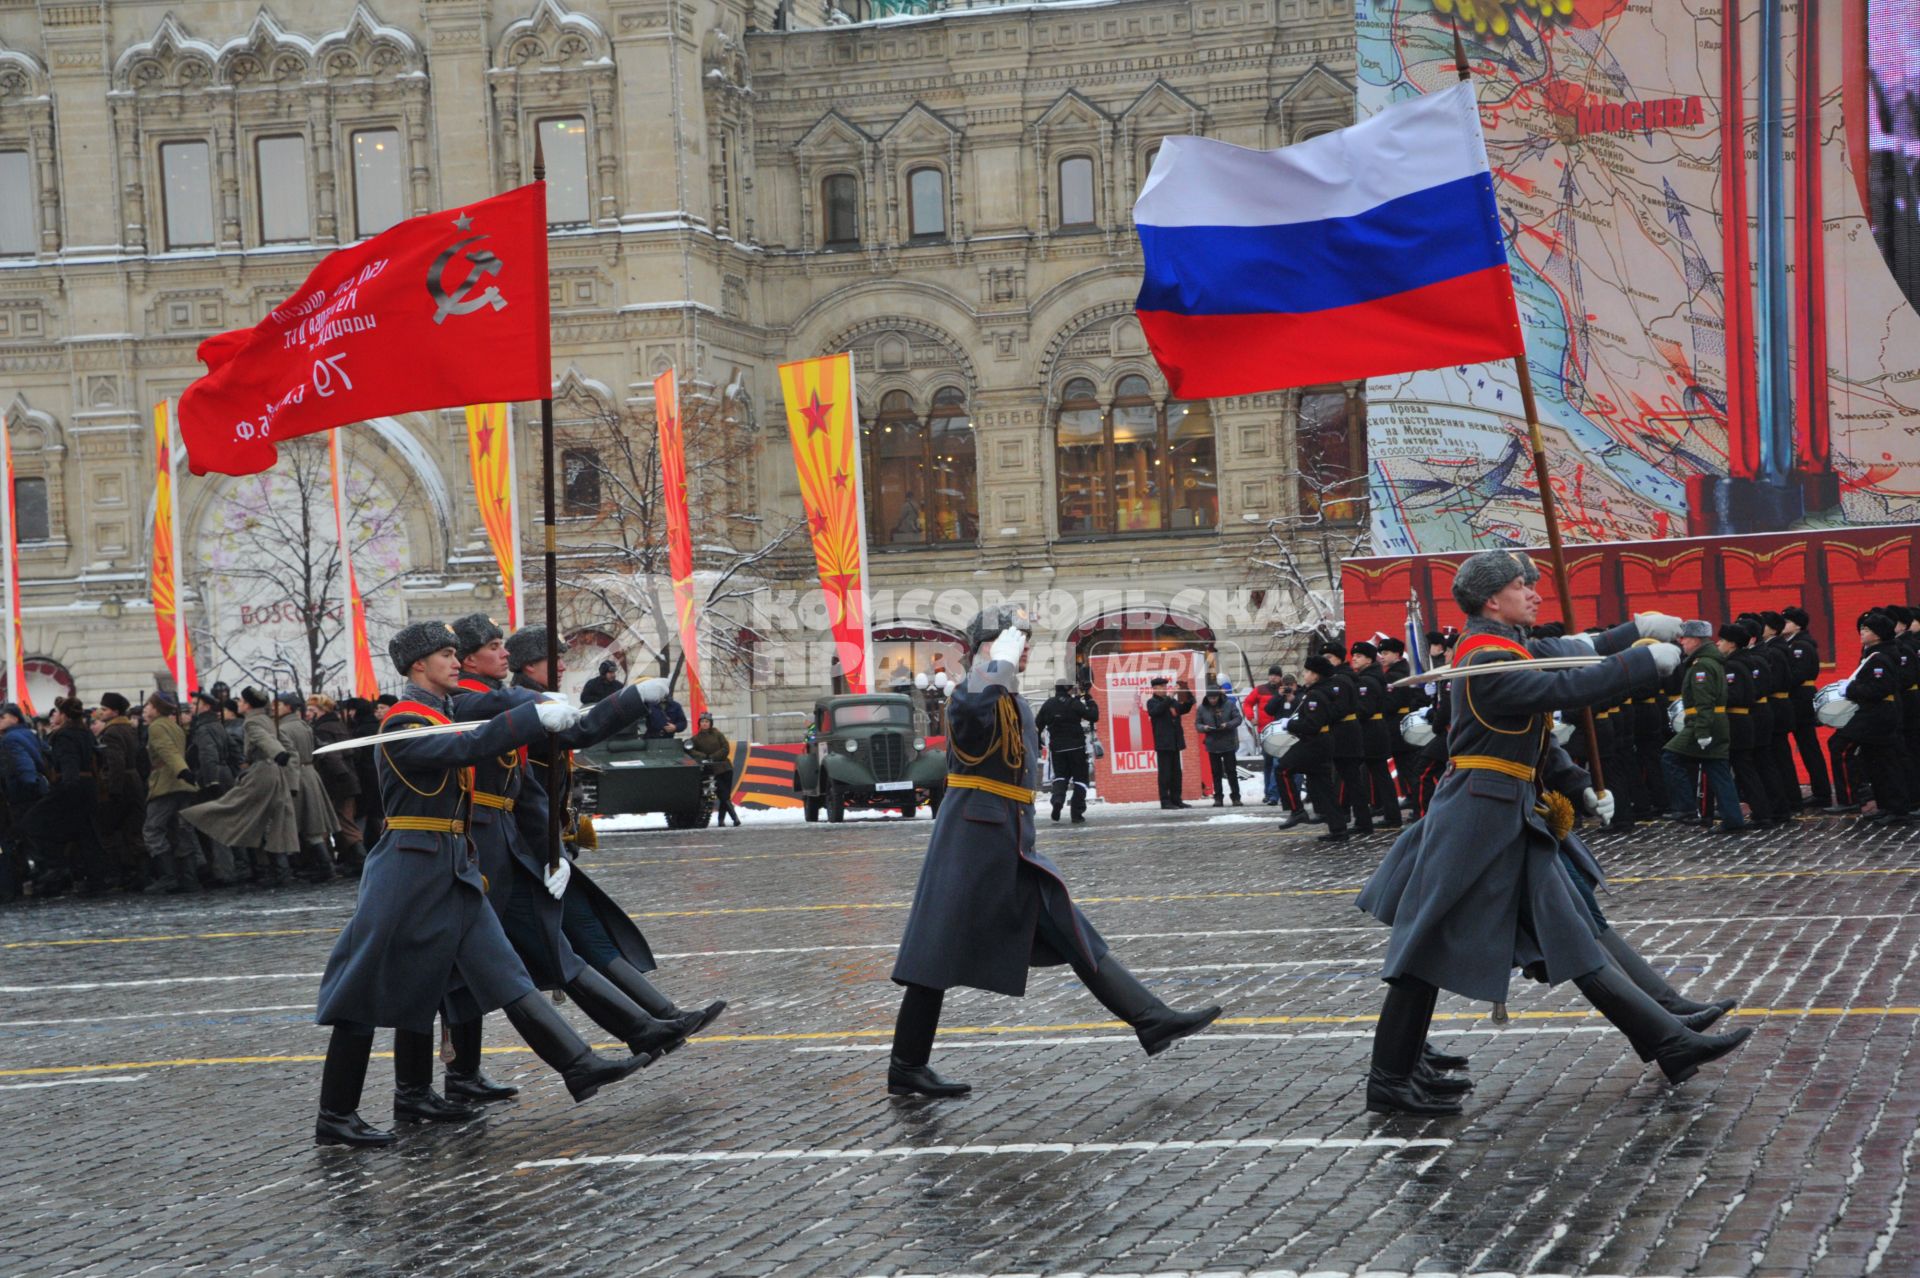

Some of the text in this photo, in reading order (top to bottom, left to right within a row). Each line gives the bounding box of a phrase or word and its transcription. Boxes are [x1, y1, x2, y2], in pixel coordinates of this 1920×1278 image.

[1576, 95, 1705, 136] МОСКВА
[1390, 404, 1430, 415] Провал
[1398, 415, 1465, 430] наступления
[1385, 424, 1443, 438] на Москву
